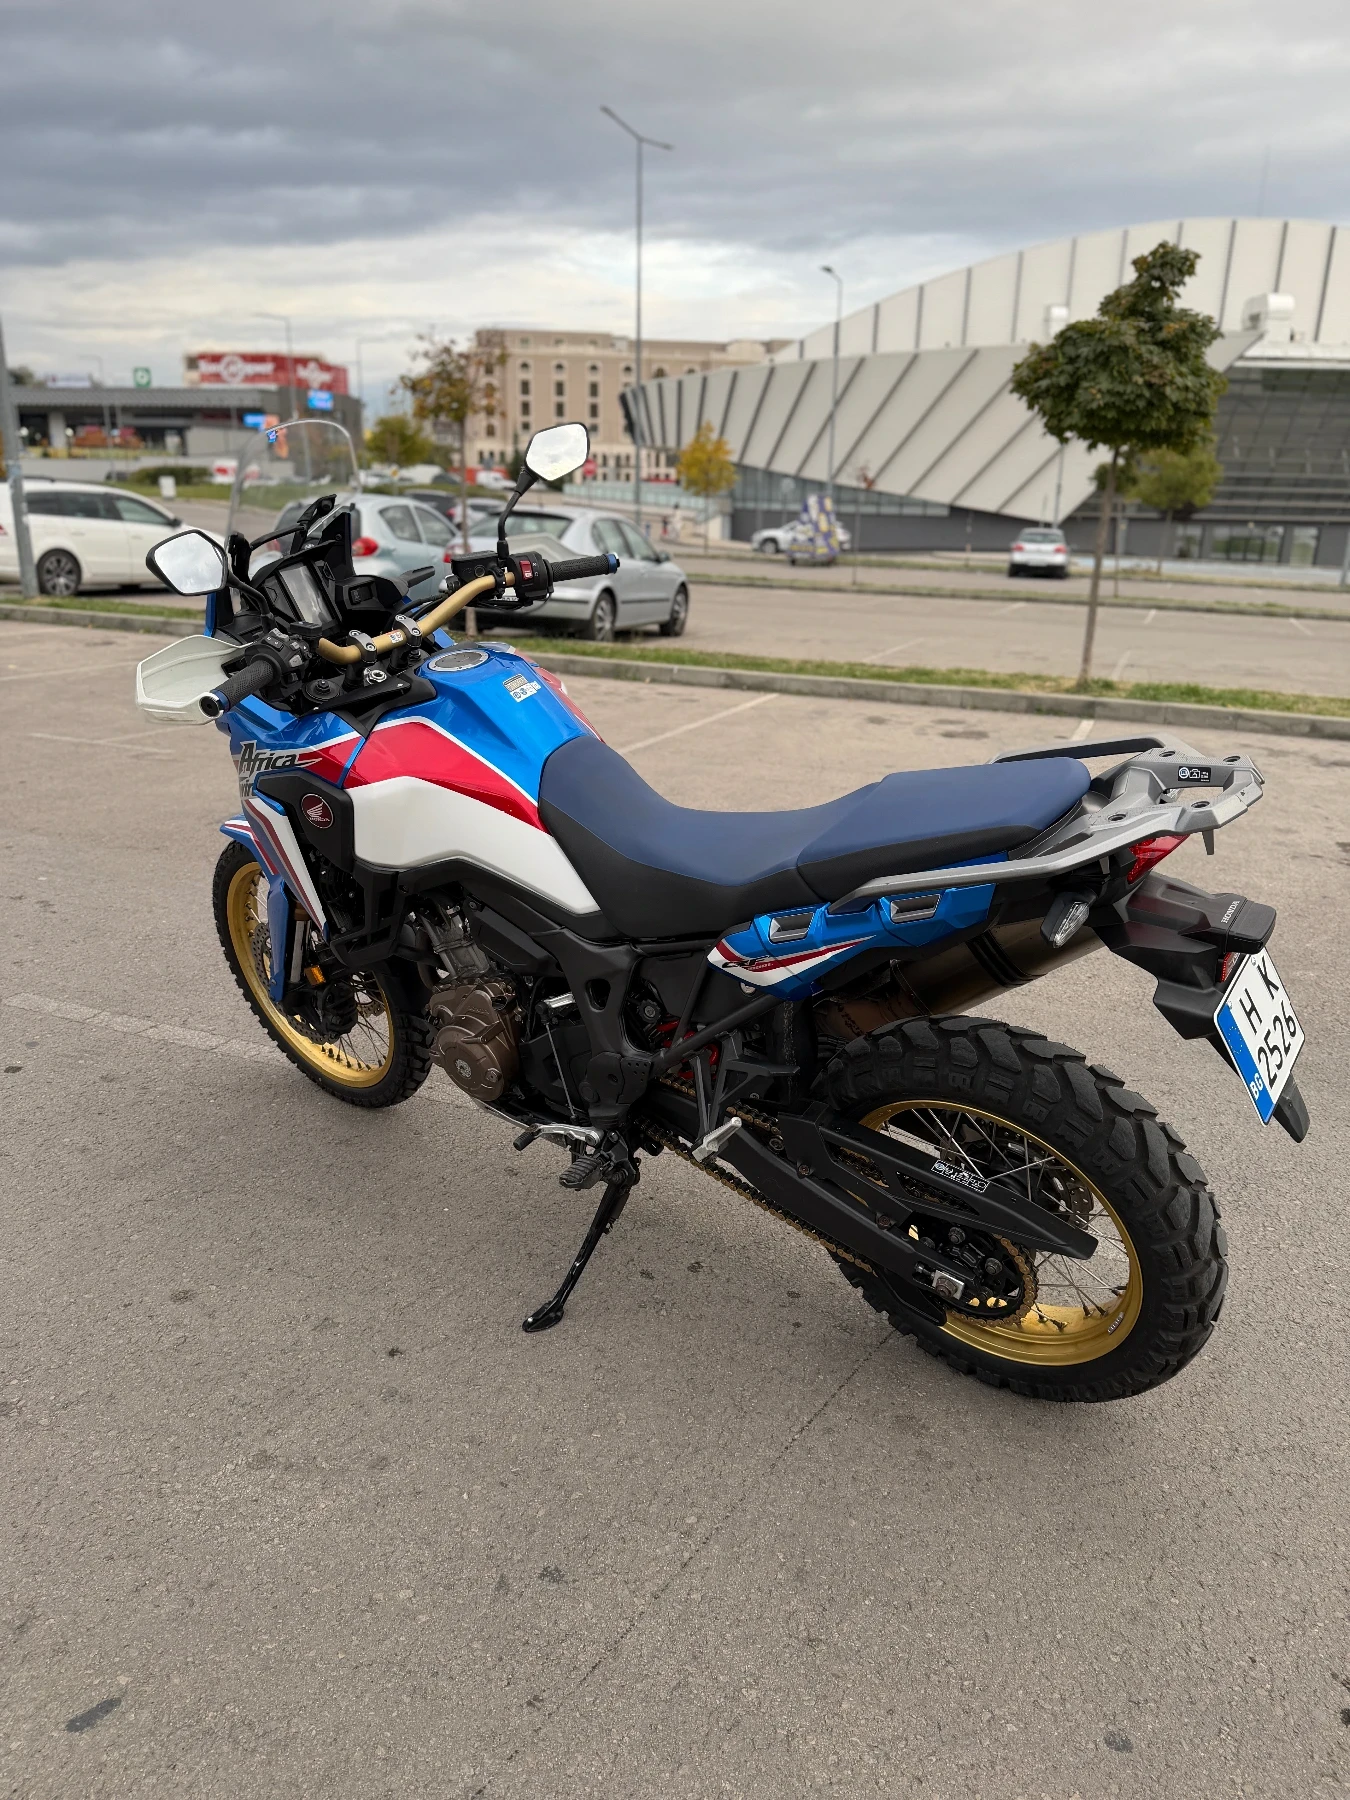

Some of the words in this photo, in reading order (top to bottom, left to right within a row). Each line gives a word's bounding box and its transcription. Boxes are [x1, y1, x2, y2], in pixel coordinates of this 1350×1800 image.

[240, 742, 301, 777] Africa
[1220, 900, 1241, 924] HONDA
[1239, 988, 1263, 1036] H
[1256, 955, 1280, 1001] K
[1257, 1000, 1297, 1090] 2526
[1250, 1072, 1265, 1101] BG
